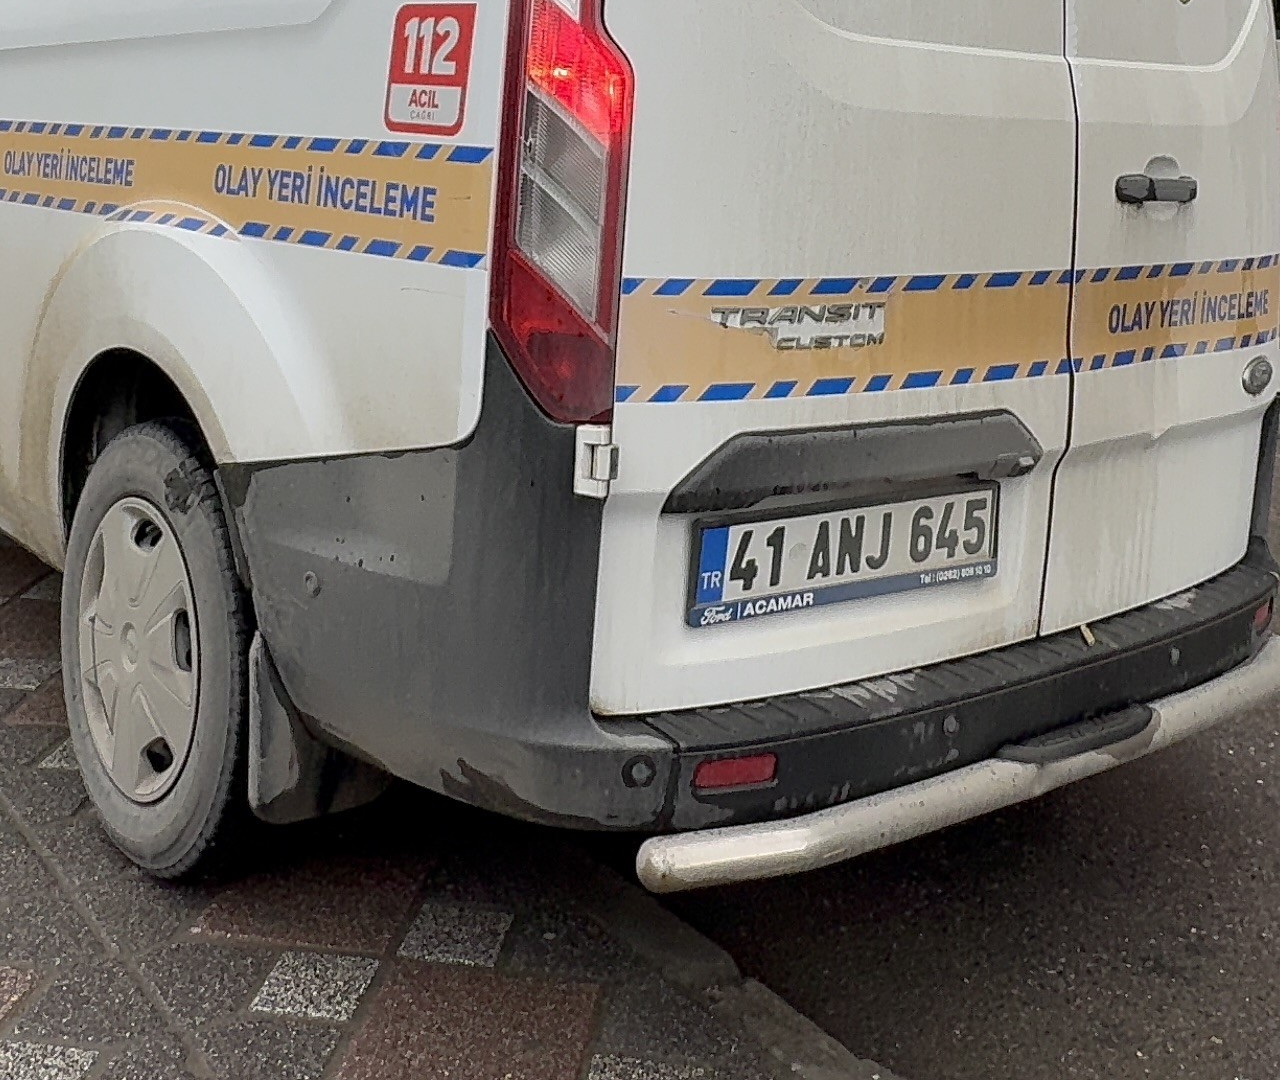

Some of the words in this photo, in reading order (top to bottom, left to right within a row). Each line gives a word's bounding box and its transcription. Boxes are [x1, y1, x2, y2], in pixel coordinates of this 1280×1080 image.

[403, 16, 461, 75] 112
[4, 150, 34, 177] OLAY
[36, 148, 64, 179] YERİ
[65, 148, 135, 187] İNCELEME
[214, 163, 263, 199] OLAY
[267, 165, 313, 206] YERİ
[316, 165, 438, 223] İNCELEME
[711, 301, 887, 328] TRANSIT
[1108, 300, 1156, 334] OLAY
[1159, 290, 1198, 328] YERİ
[1200, 288, 1269, 325] İNCELEME
[776, 331, 885, 351] CUSTOM
[729, 524, 786, 591] 41
[807, 510, 893, 581] ANJ
[909, 496, 987, 564] 645
[701, 570, 721, 590] TR
[700, 604, 732, 626] Ford
[743, 591, 814, 617] ACAMAR
